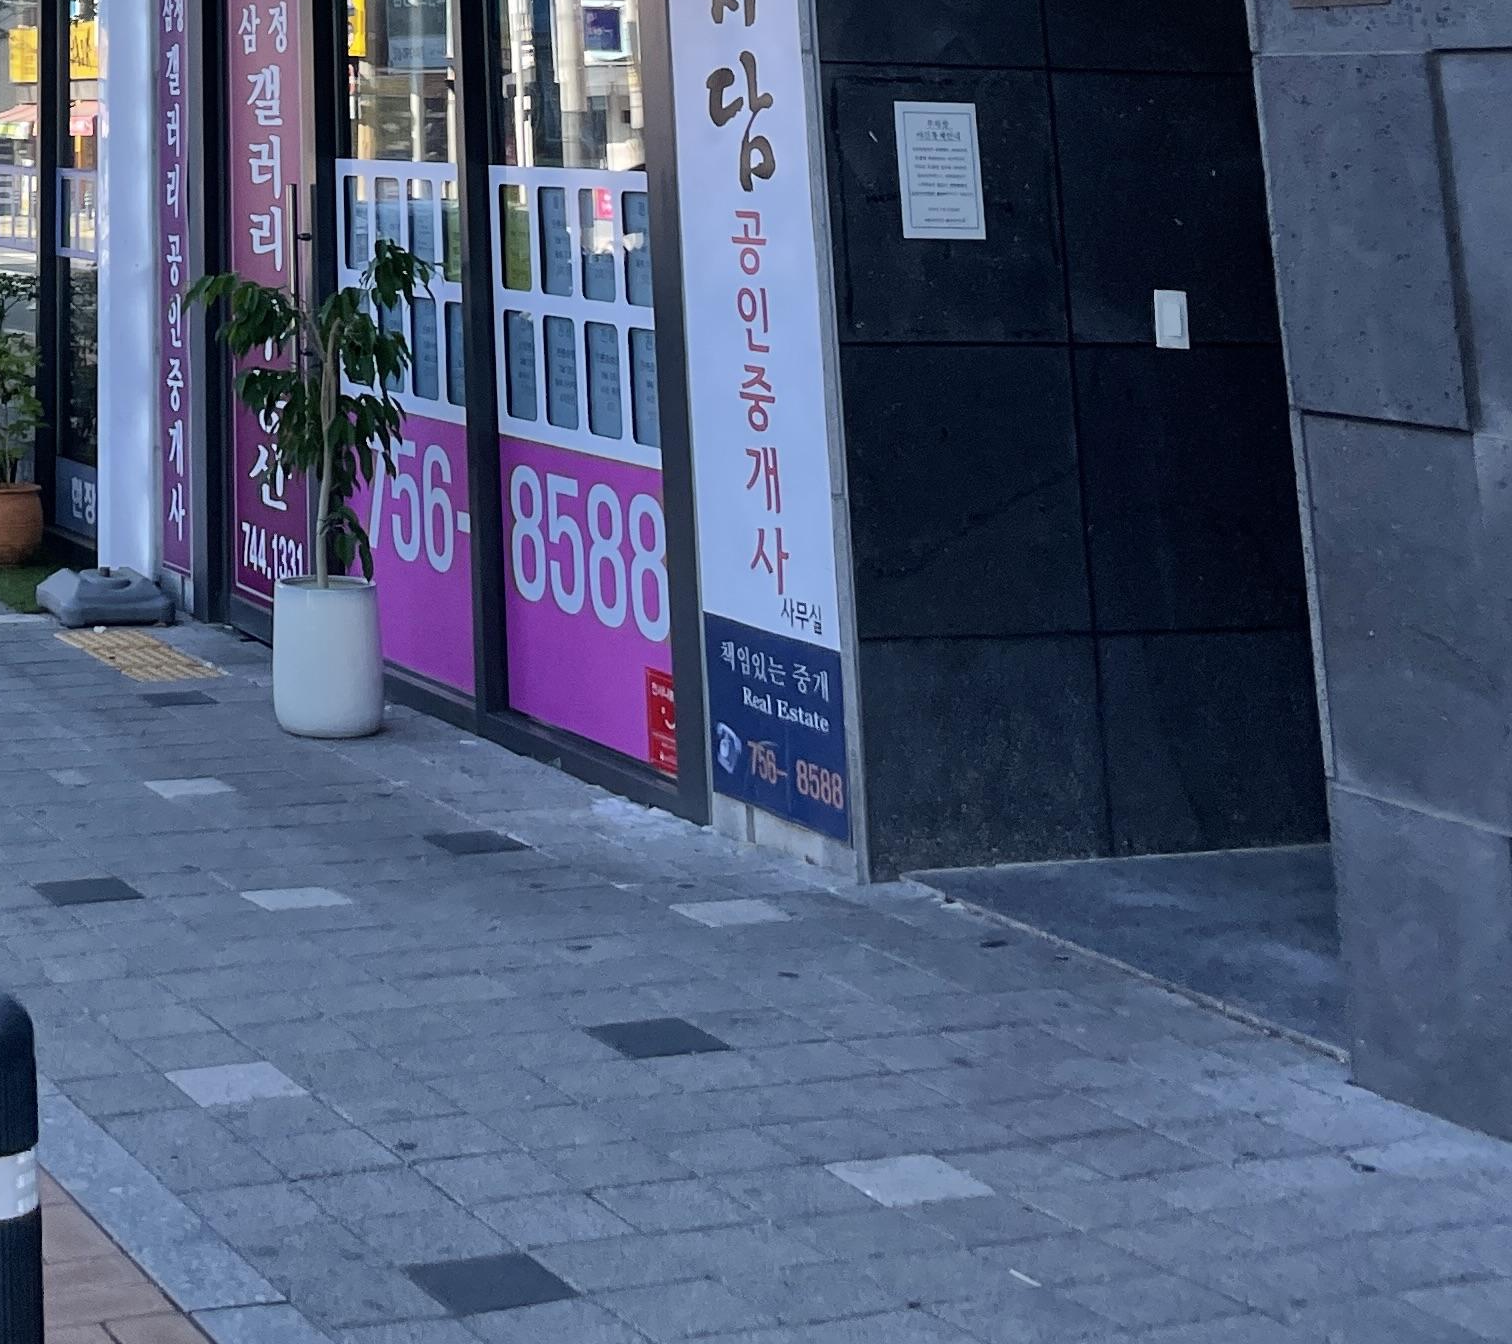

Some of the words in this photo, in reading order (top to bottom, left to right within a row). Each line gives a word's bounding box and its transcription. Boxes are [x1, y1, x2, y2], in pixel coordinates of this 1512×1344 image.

[238, 1, 289, 55] 삼정
[165, 43, 182, 218] 갤러리
[246, 64, 285, 272] 갤러리
[166, 234, 187, 543] 공인중개사
[731, 208, 790, 596] 공인중개사
[241, 521, 304, 580] 744.1331
[510, 464, 671, 643] 8588
[780, 597, 823, 636] 사무실
[719, 641, 786, 687] 책임있는
[792, 663, 829, 703] 중개
[742, 686, 773, 716] Real
[776, 697, 831, 734] Estate
[747, 739, 788, 785] 756-
[795, 758, 845, 811] 8588
